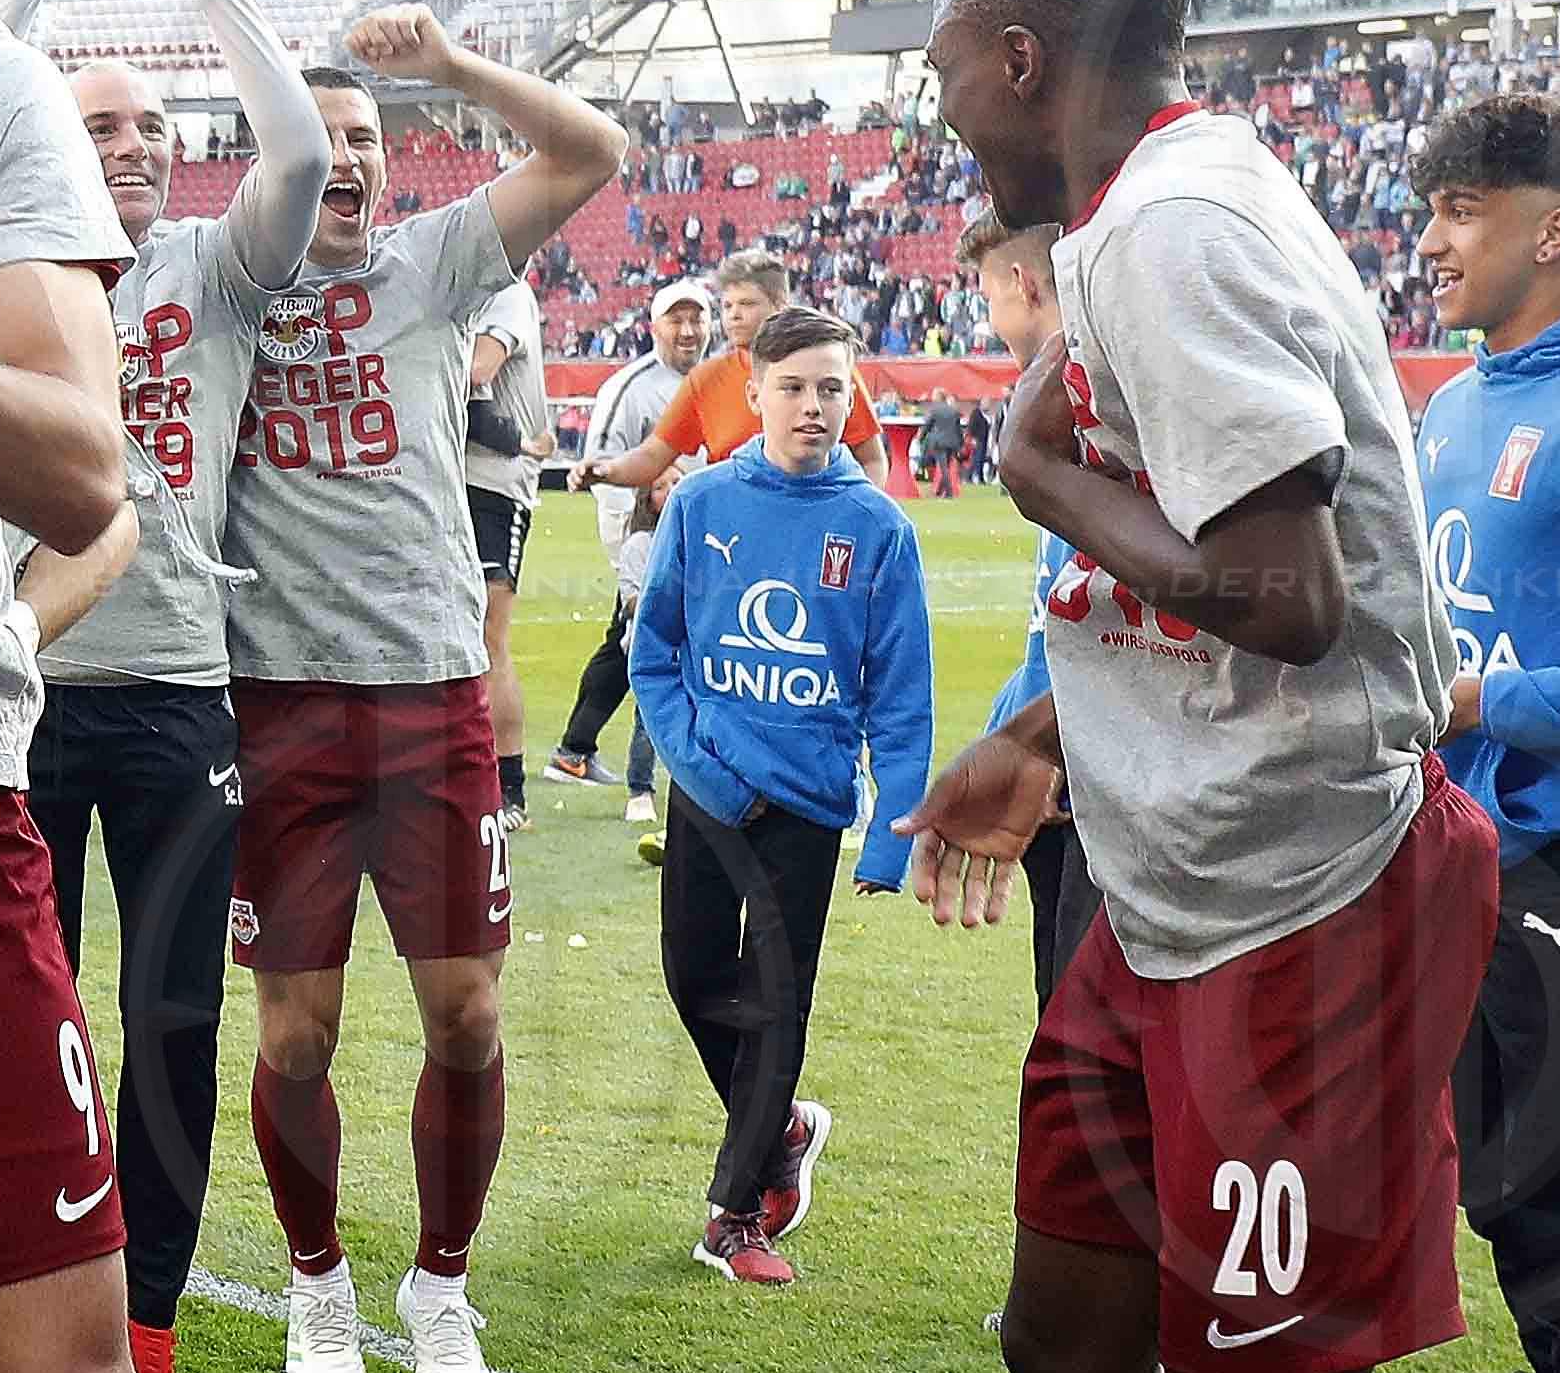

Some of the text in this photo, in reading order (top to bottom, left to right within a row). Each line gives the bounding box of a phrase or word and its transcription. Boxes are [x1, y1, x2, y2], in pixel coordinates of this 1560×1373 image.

[703, 657, 840, 706] UNIQA
[57, 1020, 99, 1155] 9
[1212, 1160, 1308, 1296] 20
